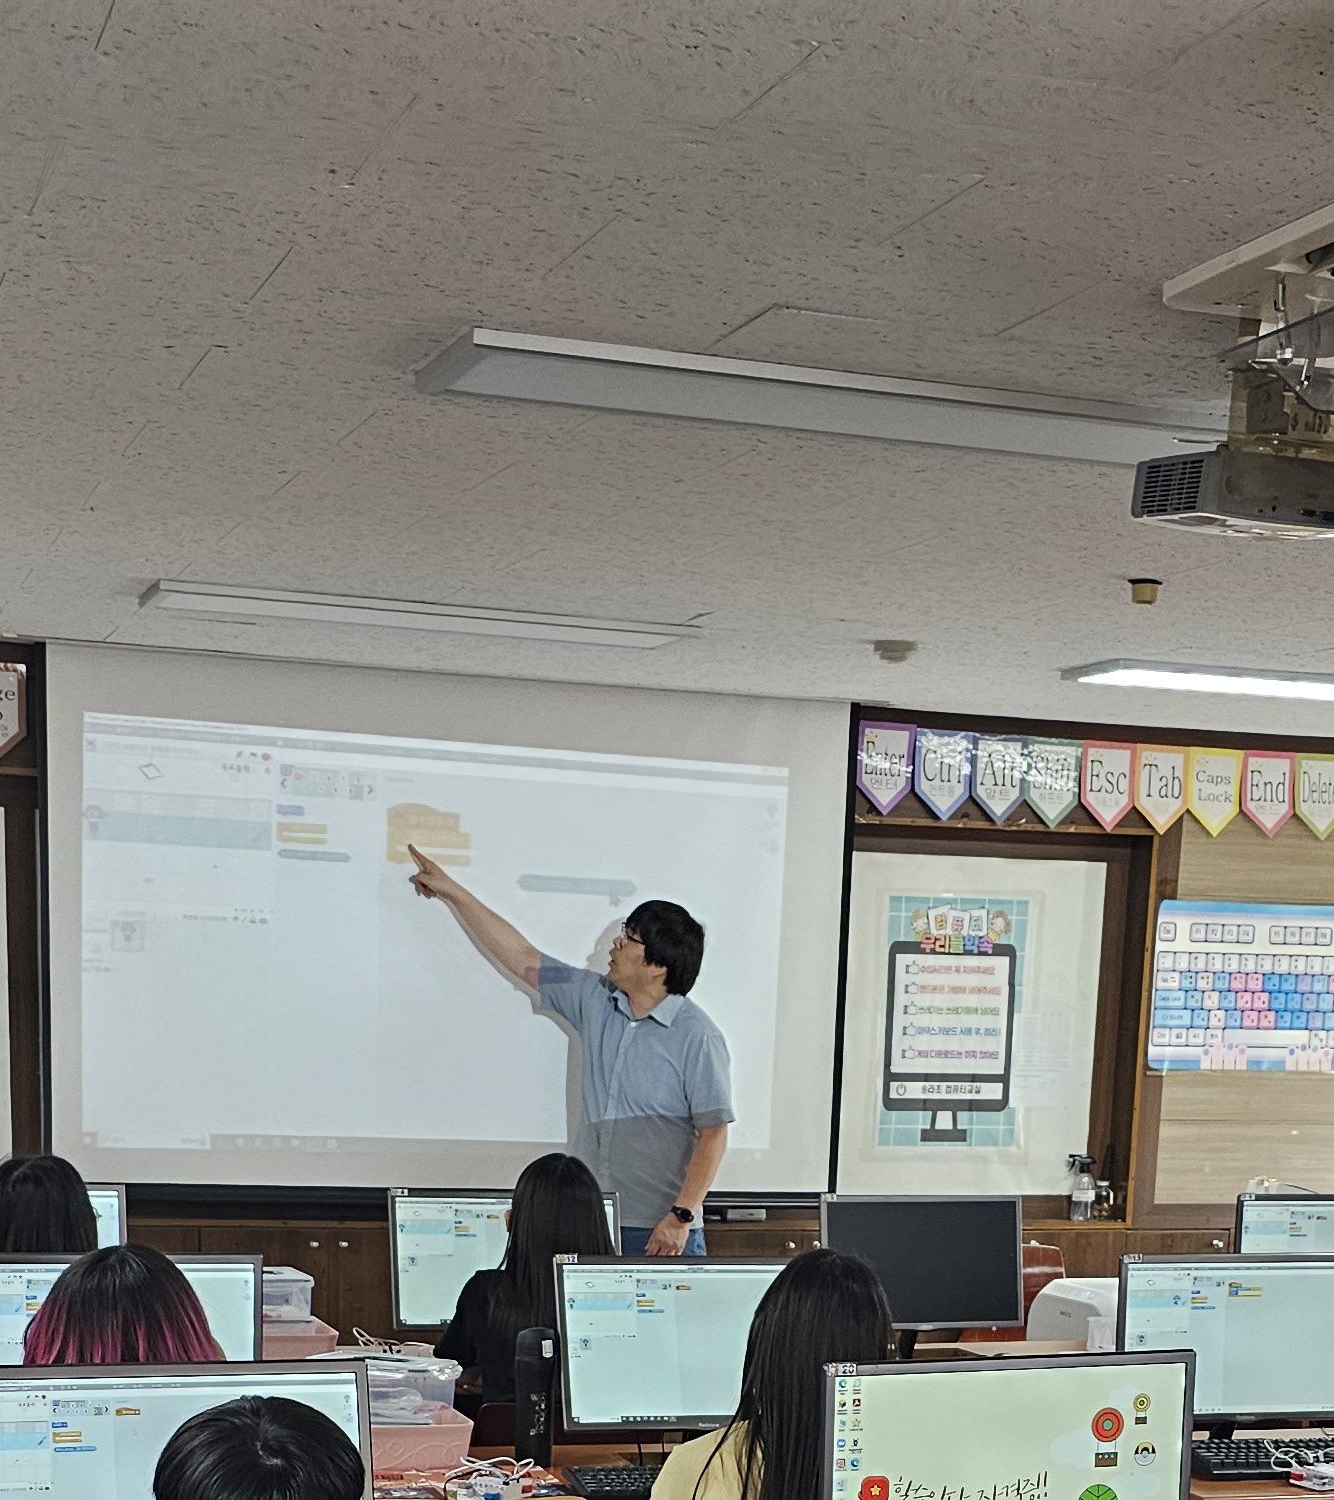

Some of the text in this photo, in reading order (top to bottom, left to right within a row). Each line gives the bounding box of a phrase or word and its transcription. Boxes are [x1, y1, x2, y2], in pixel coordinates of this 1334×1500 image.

[864, 740, 905, 779] Enter
[923, 748, 962, 784] Ctrl
[980, 752, 1017, 788] Alt
[1089, 760, 1127, 795] Esc
[1196, 770, 1231, 787] Caps
[871, 777, 898, 791] 엔터
[1144, 764, 1182, 800] Tab
[1250, 770, 1287, 804] End
[985, 787, 1011, 801] 알트
[1198, 788, 1233, 803] Lock
[934, 912, 984, 932] 컴퓨터
[945, 1084, 981, 1095] 컴퓨터교실
[842, 1365, 855, 1374] 20
